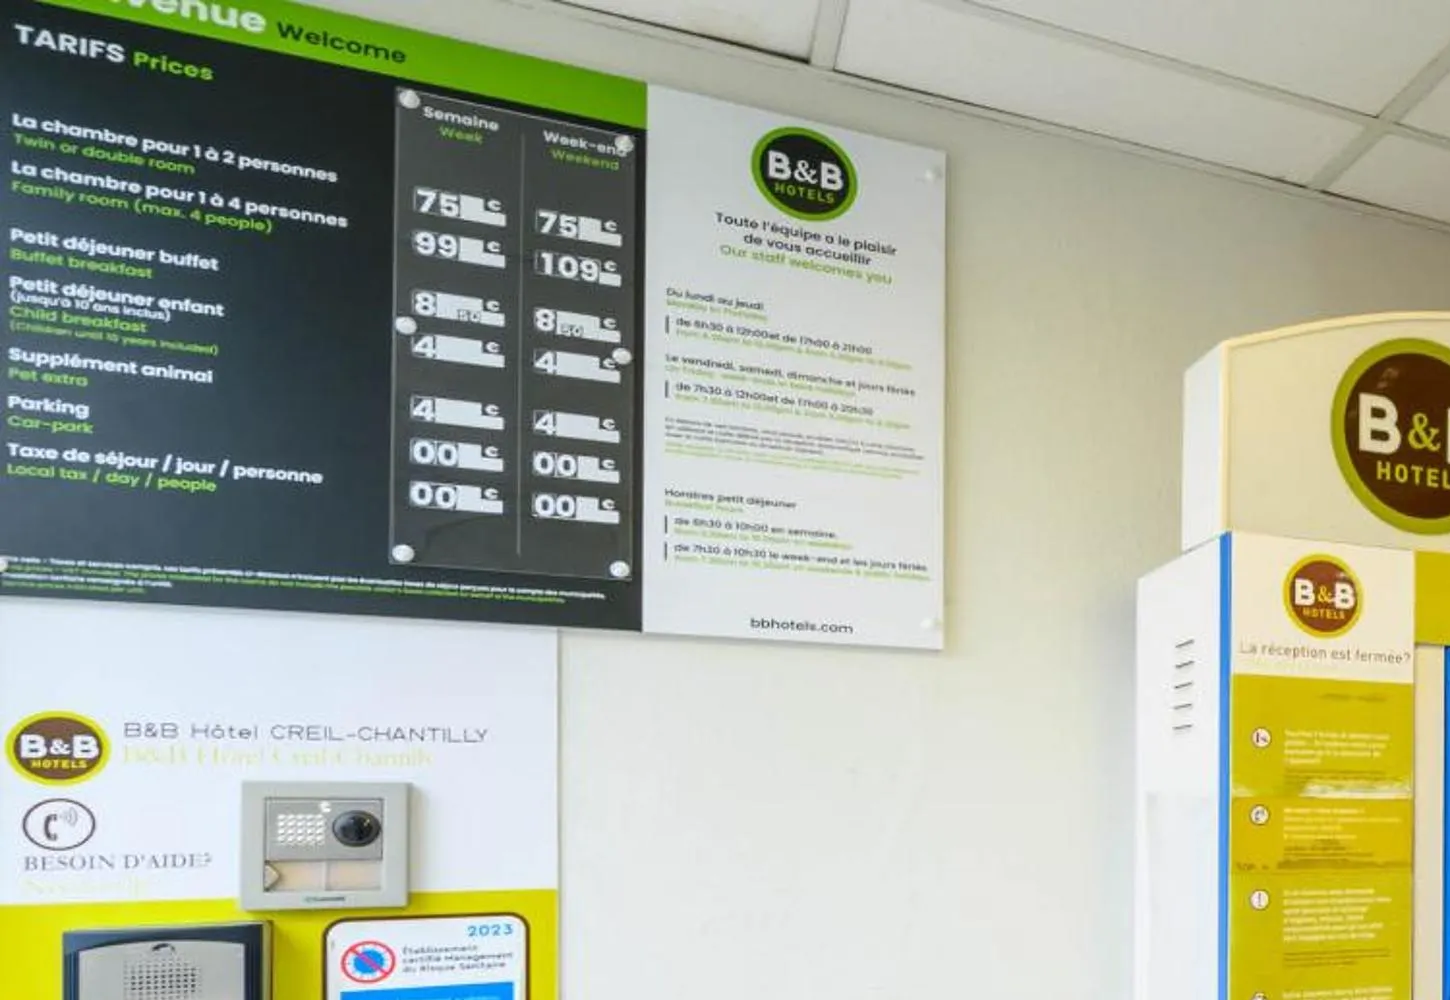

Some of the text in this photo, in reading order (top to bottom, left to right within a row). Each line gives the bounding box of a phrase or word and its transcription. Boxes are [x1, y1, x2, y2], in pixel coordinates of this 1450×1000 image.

[112, 0, 407, 64] venue Welcome
[14, 24, 214, 81] TARIFS Prices
[423, 105, 499, 132] Semaine
[12, 113, 338, 183] La chambre pour 1 à 2 personnes
[439, 126, 483, 145] Week
[14, 133, 195, 174] Twin or double room
[552, 149, 619, 171] Weekend
[767, 150, 844, 191] B&B
[12, 161, 348, 228] La chambre pour 1 à 4 personnes
[416, 188, 460, 218] 75
[774, 182, 835, 204] HOTELS
[11, 181, 273, 234] Family room (max. 4 people)
[716, 211, 758, 230] Toute
[538, 211, 578, 238] 75
[10, 228, 219, 271] Petit déjeuner buffet
[414, 232, 457, 259] 99
[743, 232, 871, 266] de vous accueillir
[9, 248, 152, 279] Buffet breakfast
[541, 252, 600, 282] 109
[720, 244, 892, 285] Our staff welcomes you
[9, 275, 225, 317] Petit déjeuner enfant
[415, 292, 436, 316] 8
[9, 305, 148, 333] Child breakfast
[93, 303, 120, 315] ans
[123, 304, 171, 322] inclus)
[535, 308, 556, 332] 8
[413, 335, 436, 358] 4
[8, 347, 214, 384] Supplément animal
[534, 352, 556, 375] 4
[8, 366, 88, 388] Pet extra
[7, 394, 90, 420] Parking
[413, 398, 434, 421] 4
[7, 415, 94, 434] Car-park
[535, 412, 556, 436] 4
[6, 442, 323, 485] Taxe de séjour / jour / personne
[412, 441, 458, 467] 00
[533, 452, 577, 477] 00
[7, 462, 55, 479] Local
[59, 466, 87, 482] tax
[105, 470, 140, 489] day
[157, 474, 217, 493] people
[410, 483, 456, 509] 00
[535, 494, 576, 517] 00
[1294, 577, 1355, 610] B&B
[750, 617, 853, 635] bbhotels.com
[1302, 607, 1345, 620] HOTELS
[1240, 641, 1257, 655] La
[1261, 644, 1327, 661] réception
[1330, 648, 1351, 662] est
[123, 722, 489, 743] B&B Hôtel CREIL-CHANTILLY
[20, 733, 99, 760] B&B
[31, 758, 88, 770] HOTELS
[24, 854, 115, 872] BESOIN
[467, 924, 513, 938] 2023
